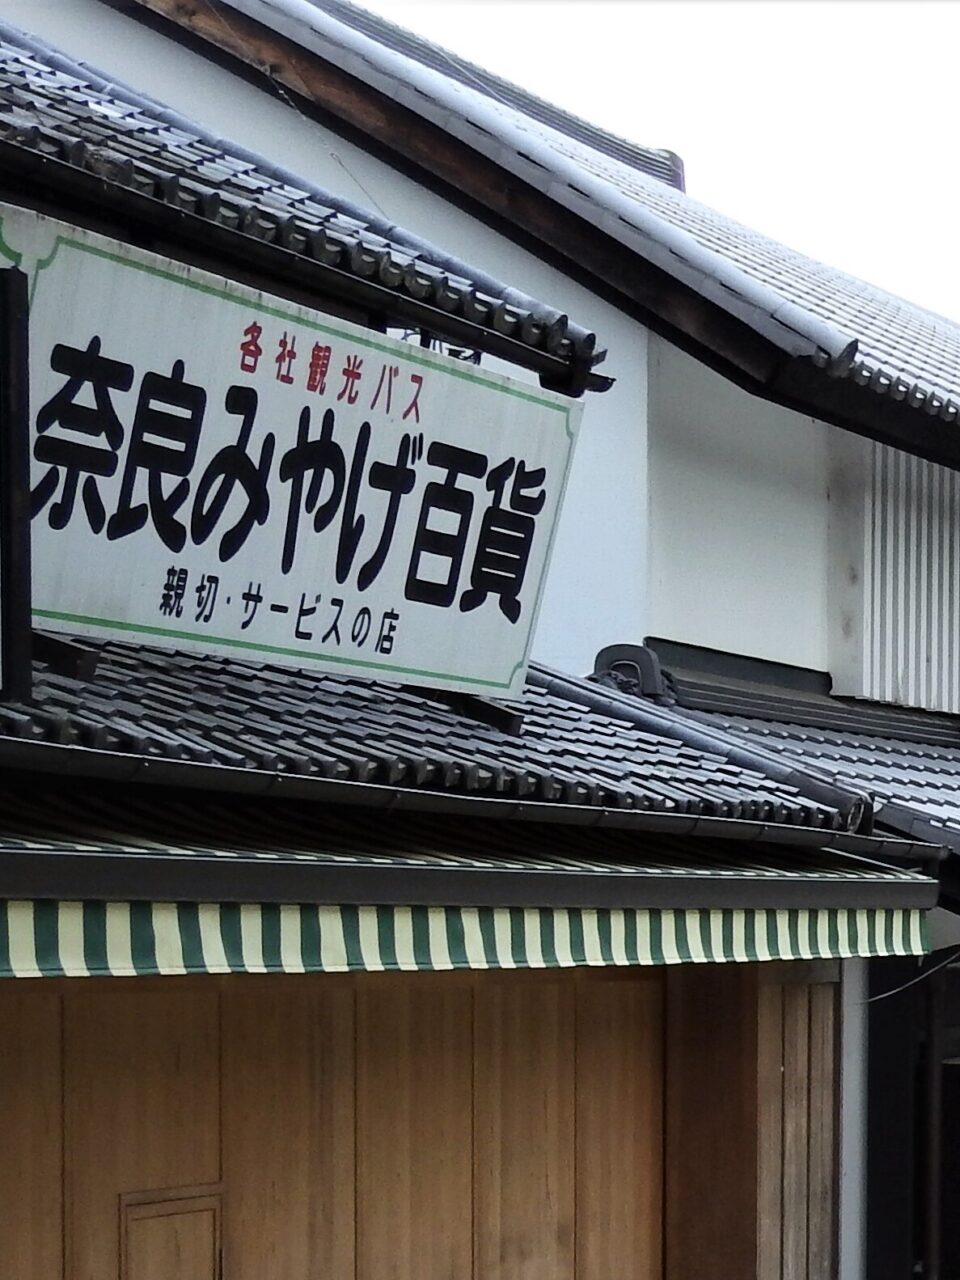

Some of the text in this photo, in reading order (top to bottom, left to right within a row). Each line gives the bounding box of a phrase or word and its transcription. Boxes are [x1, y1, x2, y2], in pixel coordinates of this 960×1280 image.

[240, 321, 424, 424] 各社観光バス
[31, 335, 547, 625] 奈良みやげ百貨
